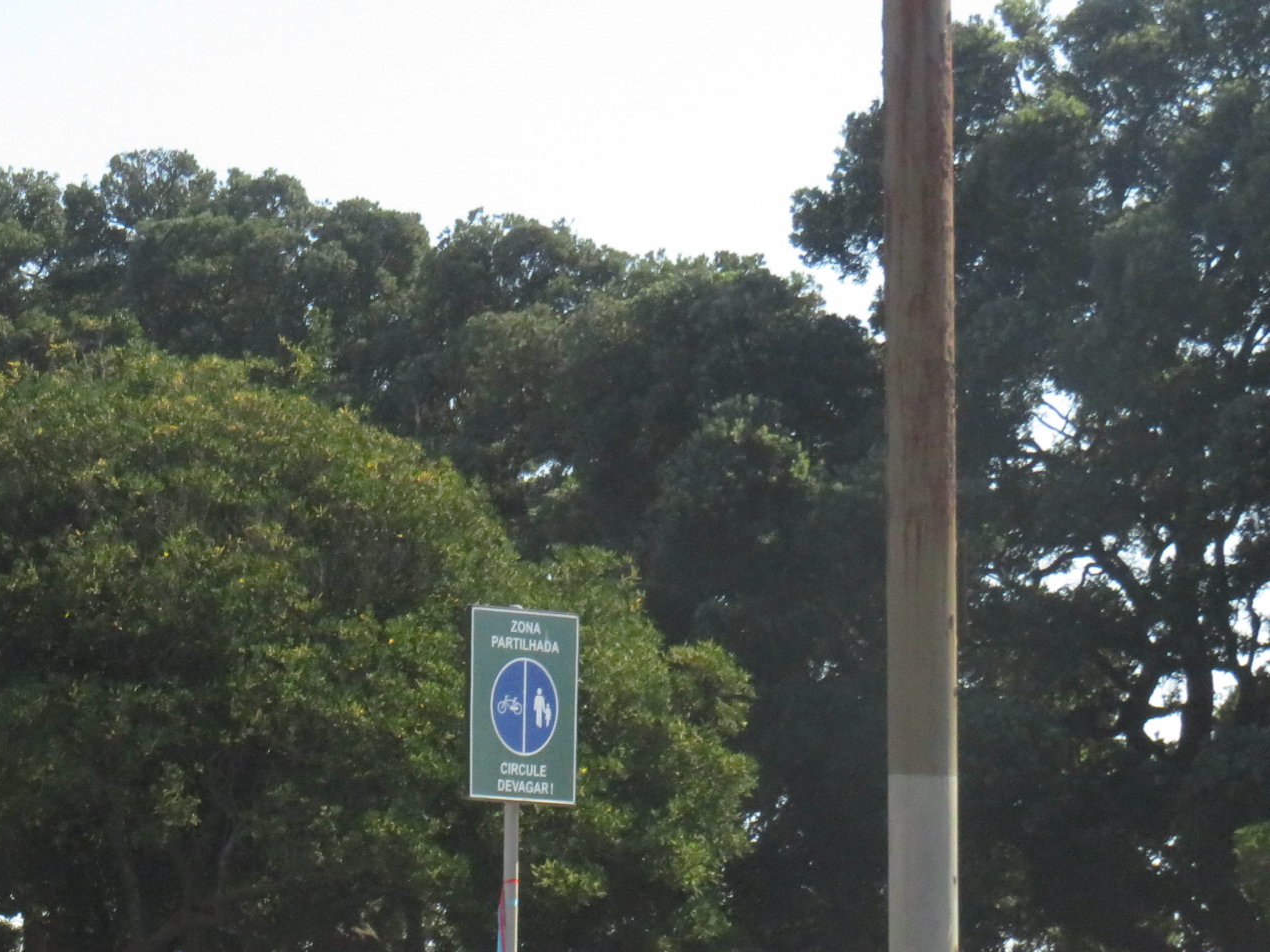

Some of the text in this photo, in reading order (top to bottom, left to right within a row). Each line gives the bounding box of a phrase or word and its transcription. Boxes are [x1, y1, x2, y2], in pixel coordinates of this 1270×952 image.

[510, 620, 541, 634] ZONA
[491, 635, 560, 653] PARTILHADA
[500, 762, 547, 777] CIRCULE
